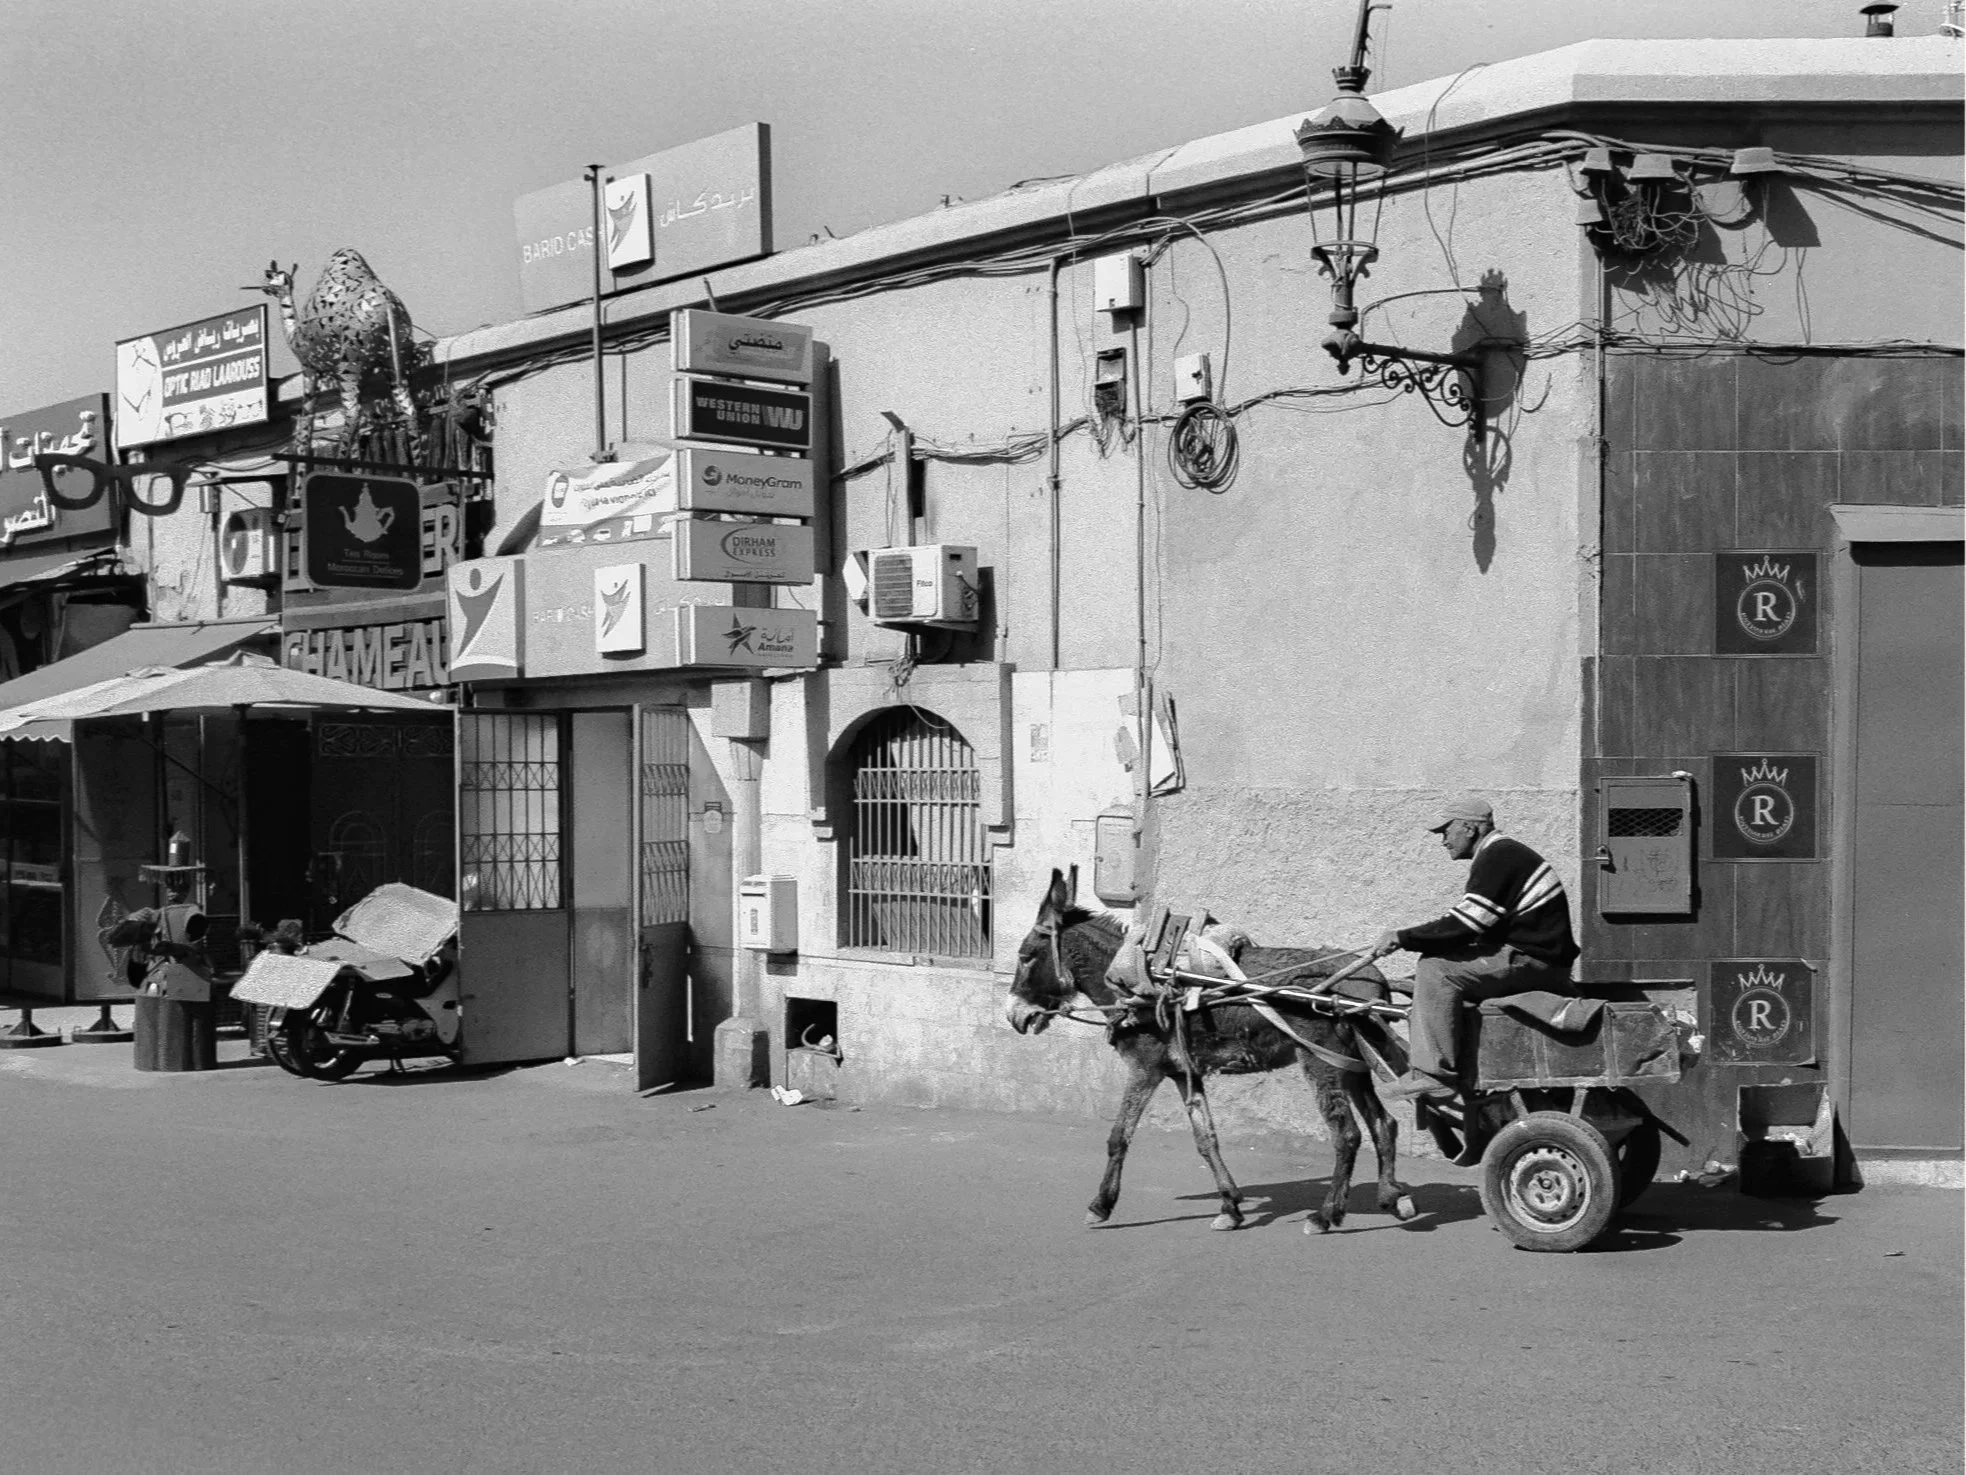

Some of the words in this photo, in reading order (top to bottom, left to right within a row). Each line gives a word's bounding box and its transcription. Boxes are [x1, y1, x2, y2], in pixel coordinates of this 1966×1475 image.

[522, 236, 563, 263] BARID
[164, 372, 189, 397] OPTIC
[189, 367, 212, 392] RIAD
[695, 396, 761, 414] WESTERN
[716, 410, 761, 424] UNION
[767, 405, 803, 431] WU
[726, 473, 803, 490] MoneyGram
[732, 537, 775, 547] DIRHAM
[732, 547, 776, 557] EXPRESS
[1753, 591, 1782, 621] R
[757, 642, 794, 652] Amana
[1750, 795, 1780, 825] R
[1747, 999, 1777, 1029] R
